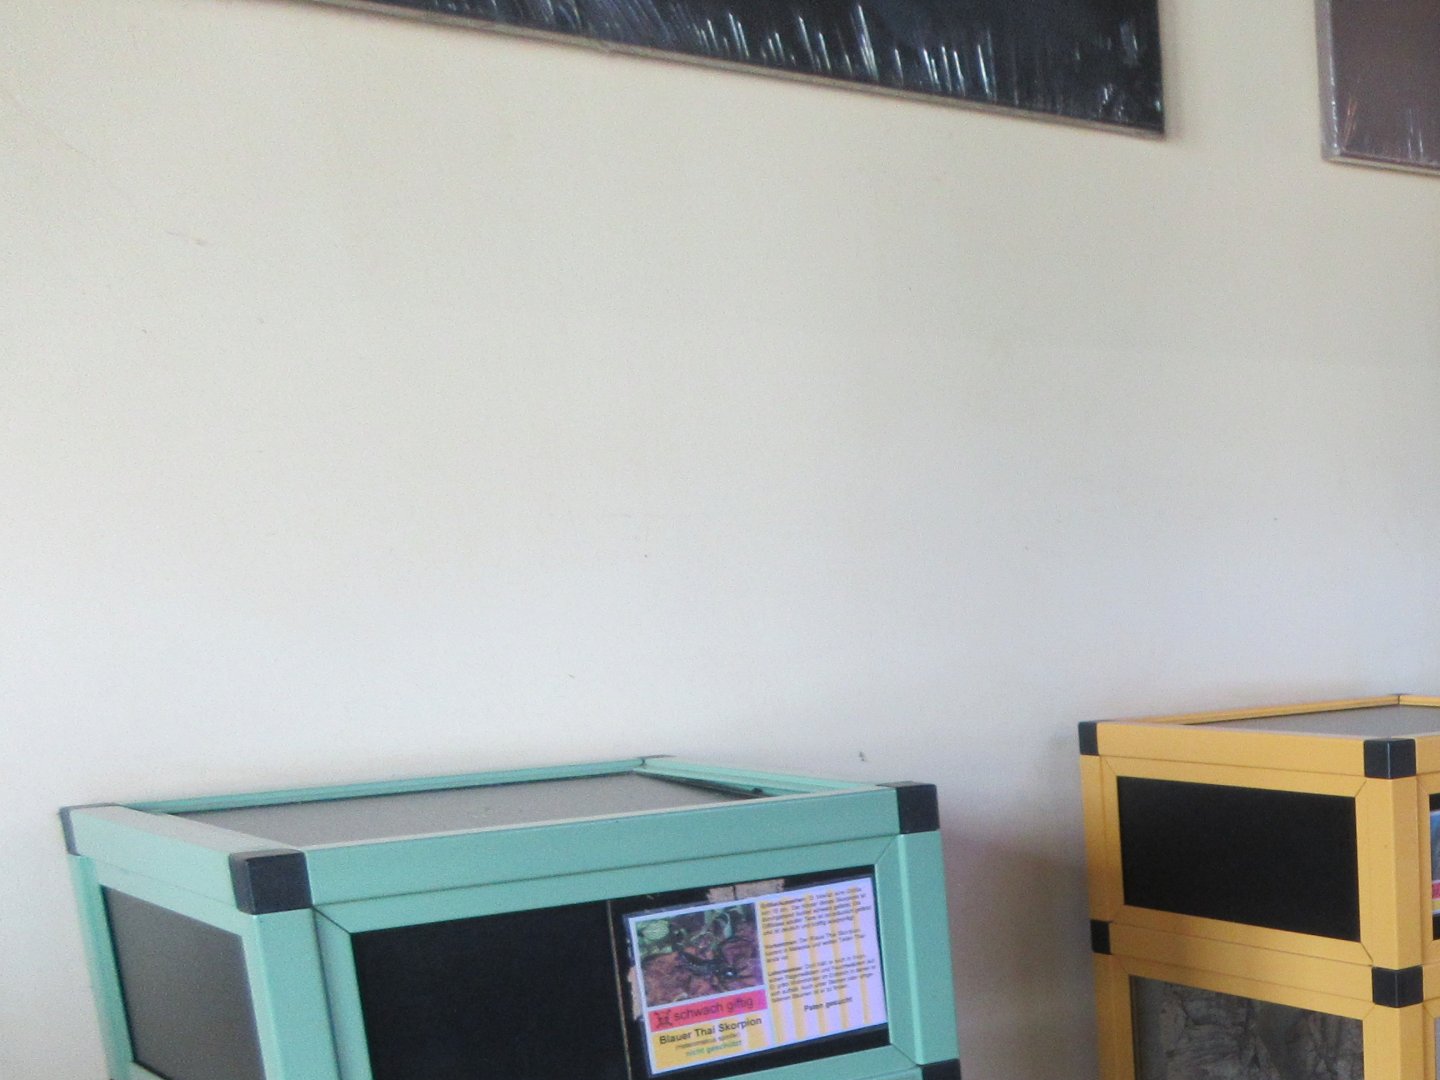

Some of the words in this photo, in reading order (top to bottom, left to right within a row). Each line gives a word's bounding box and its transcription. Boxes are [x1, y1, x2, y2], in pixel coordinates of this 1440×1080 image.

[674, 1002, 723, 1021] schwach
[727, 997, 754, 1014] giftig
[659, 1031, 693, 1045] Blauer
[694, 1027, 715, 1038] Thai
[718, 1017, 763, 1033] Skorpion
